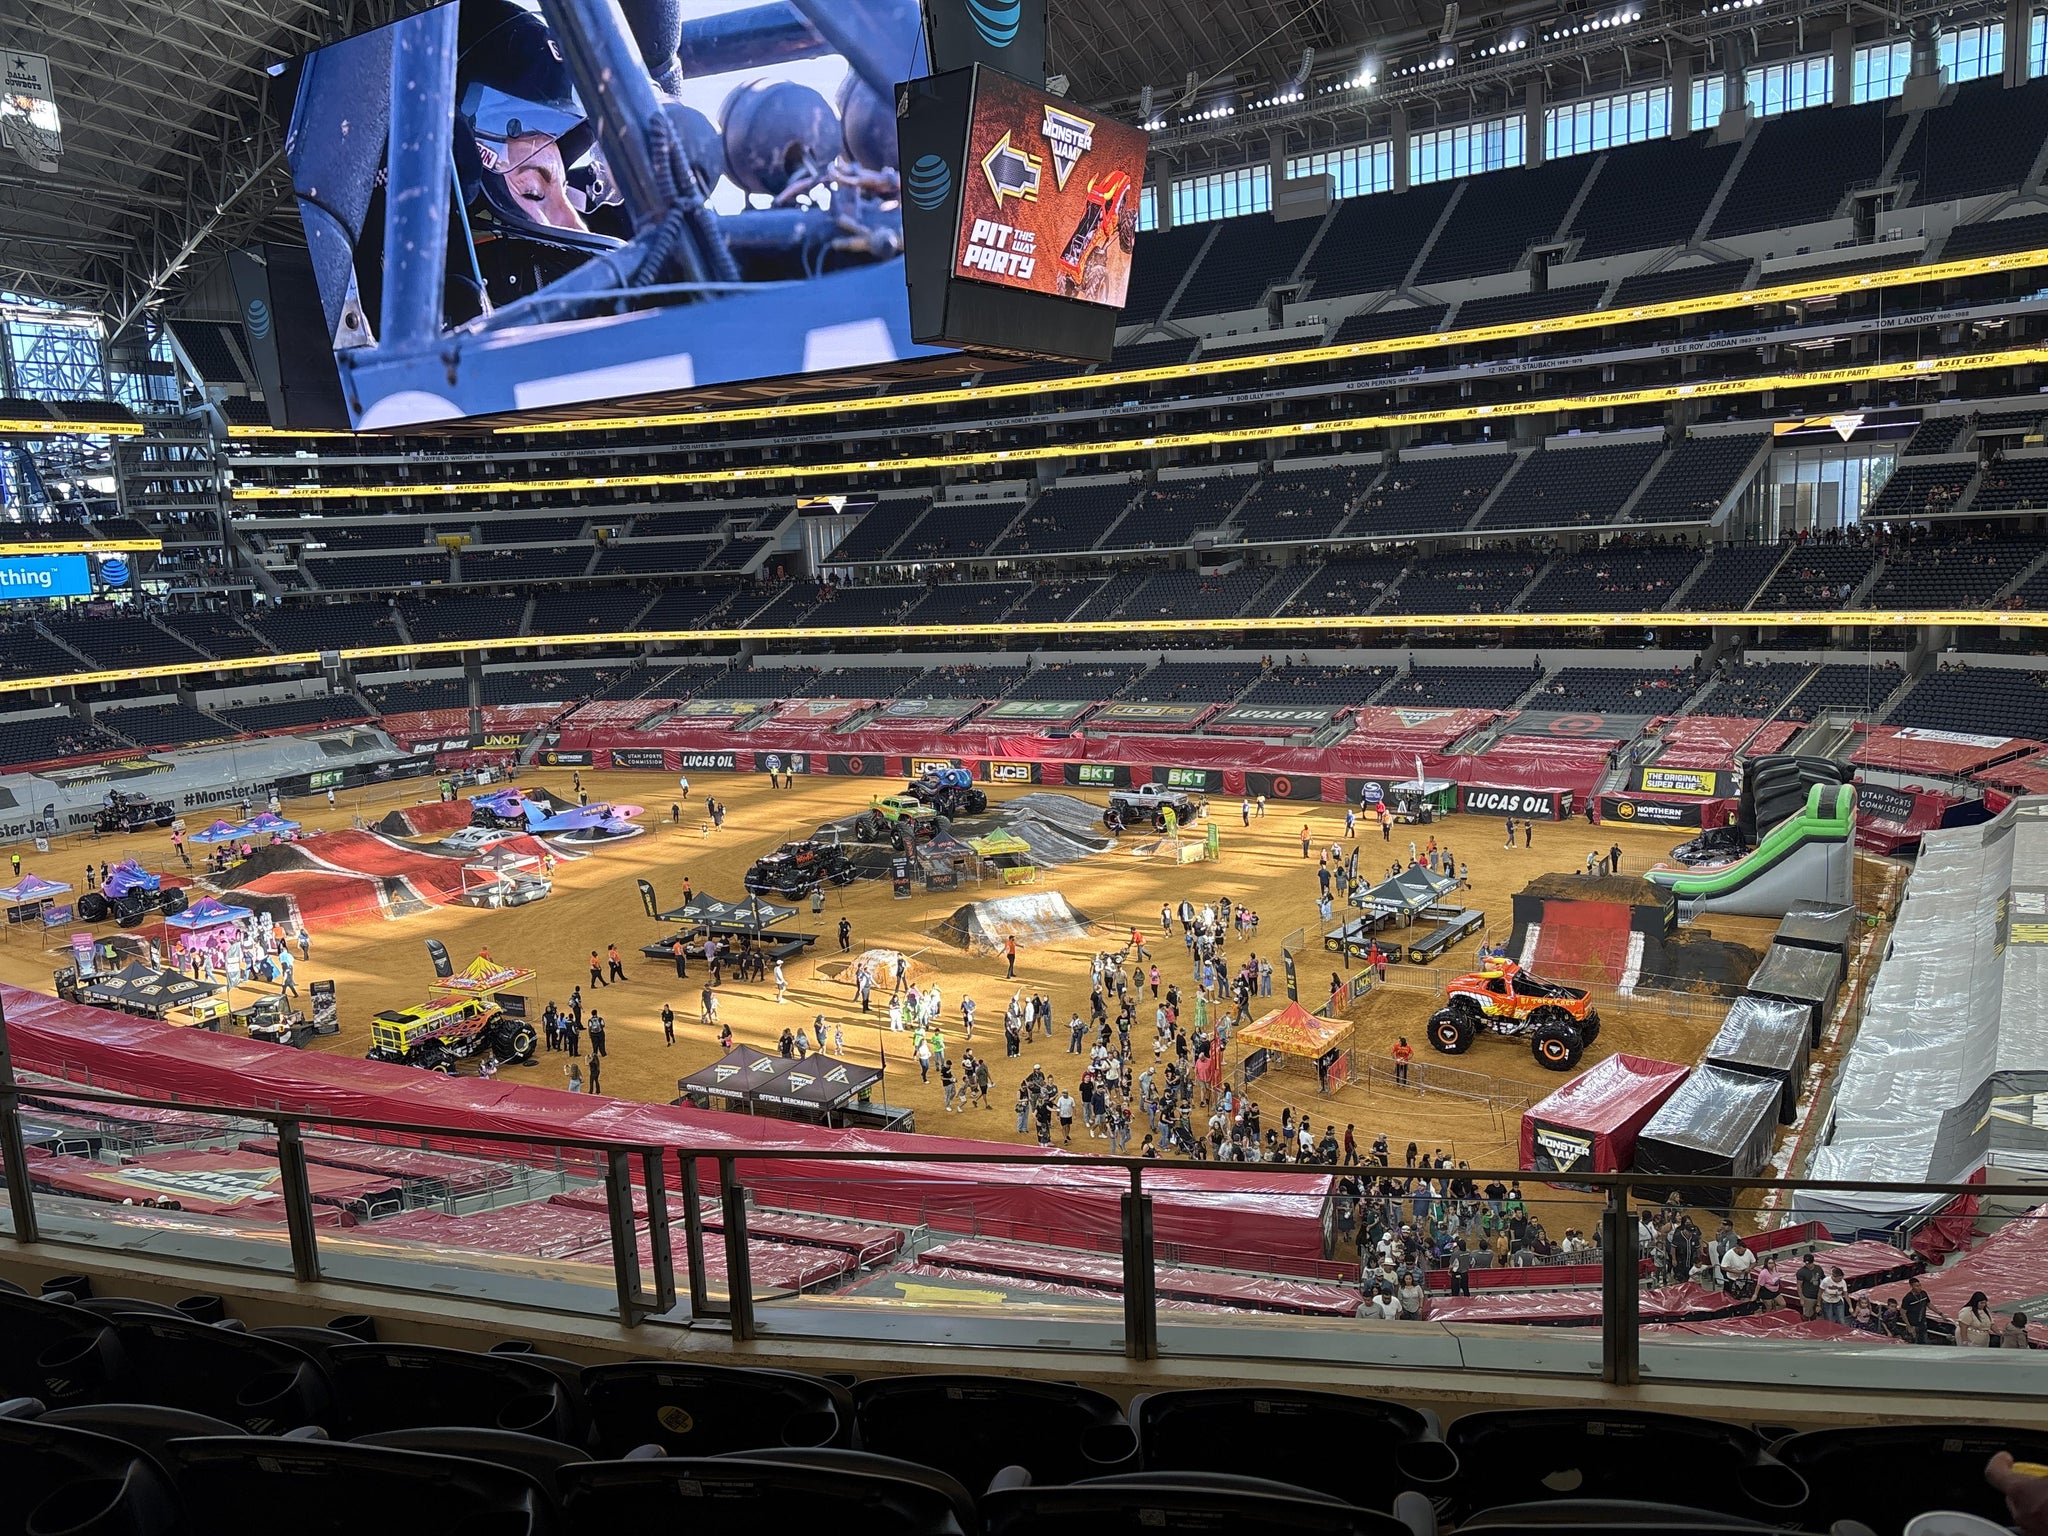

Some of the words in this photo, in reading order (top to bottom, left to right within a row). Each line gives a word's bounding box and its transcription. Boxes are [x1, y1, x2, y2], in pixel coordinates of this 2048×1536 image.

[7, 71, 36, 82] DALLAS
[5, 79, 42, 90] COWBOYS
[1042, 120, 1092, 150] MONSTER
[1053, 142, 1080, 160] JAM
[970, 218, 1012, 244] PIT
[1014, 229, 1036, 242] THIS
[1012, 240, 1036, 253] WAY
[964, 244, 1036, 280] PARTY
[1875, 319, 1894, 328] TOM
[1898, 314, 1935, 325] LANDRY
[1689, 343, 1703, 351] ROY
[1706, 339, 1737, 349] JORDAN
[1964, 356, 1994, 364] GETS!
[1499, 364, 1520, 373] ROGER
[1522, 361, 1555, 371] STAUBACH
[1846, 368, 1871, 377] PARTY
[1371, 379, 1396, 387] PERKINS
[995, 703, 1080, 712] BKT
[1228, 710, 1292, 719] LUCAS
[484, 735, 520, 745] UNOH
[684, 756, 715, 766] LUCAS
[717, 756, 734, 767] OIL
[994, 764, 1028, 778] JCB
[1080, 767, 1114, 780] BKT
[1169, 771, 1205, 784] BKT
[311, 771, 343, 787] BKT
[1664, 774, 1701, 782] ORIGINAL
[184, 779, 276, 806] #MonsterJam
[1467, 793, 1519, 811] LUCAS
[1522, 798, 1552, 814] OIL
[1862, 791, 1883, 800] UTAH
[1886, 795, 1912, 808] SPORTS
[1637, 806, 1682, 815] NORTHERN
[1860, 801, 1910, 816] COMMISSION
[171, 982, 197, 992] JCB
[1282, 1025, 1304, 1036] Toro
[686, 1084, 707, 1093] OFFICIAL
[708, 1087, 743, 1098] MERCHANDISE
[759, 1094, 782, 1103] OFFICIAL
[782, 1096, 820, 1108] MERCHANDISE
[1538, 1137, 1590, 1156] MONSTER
[1550, 1149, 1578, 1161] JAM
